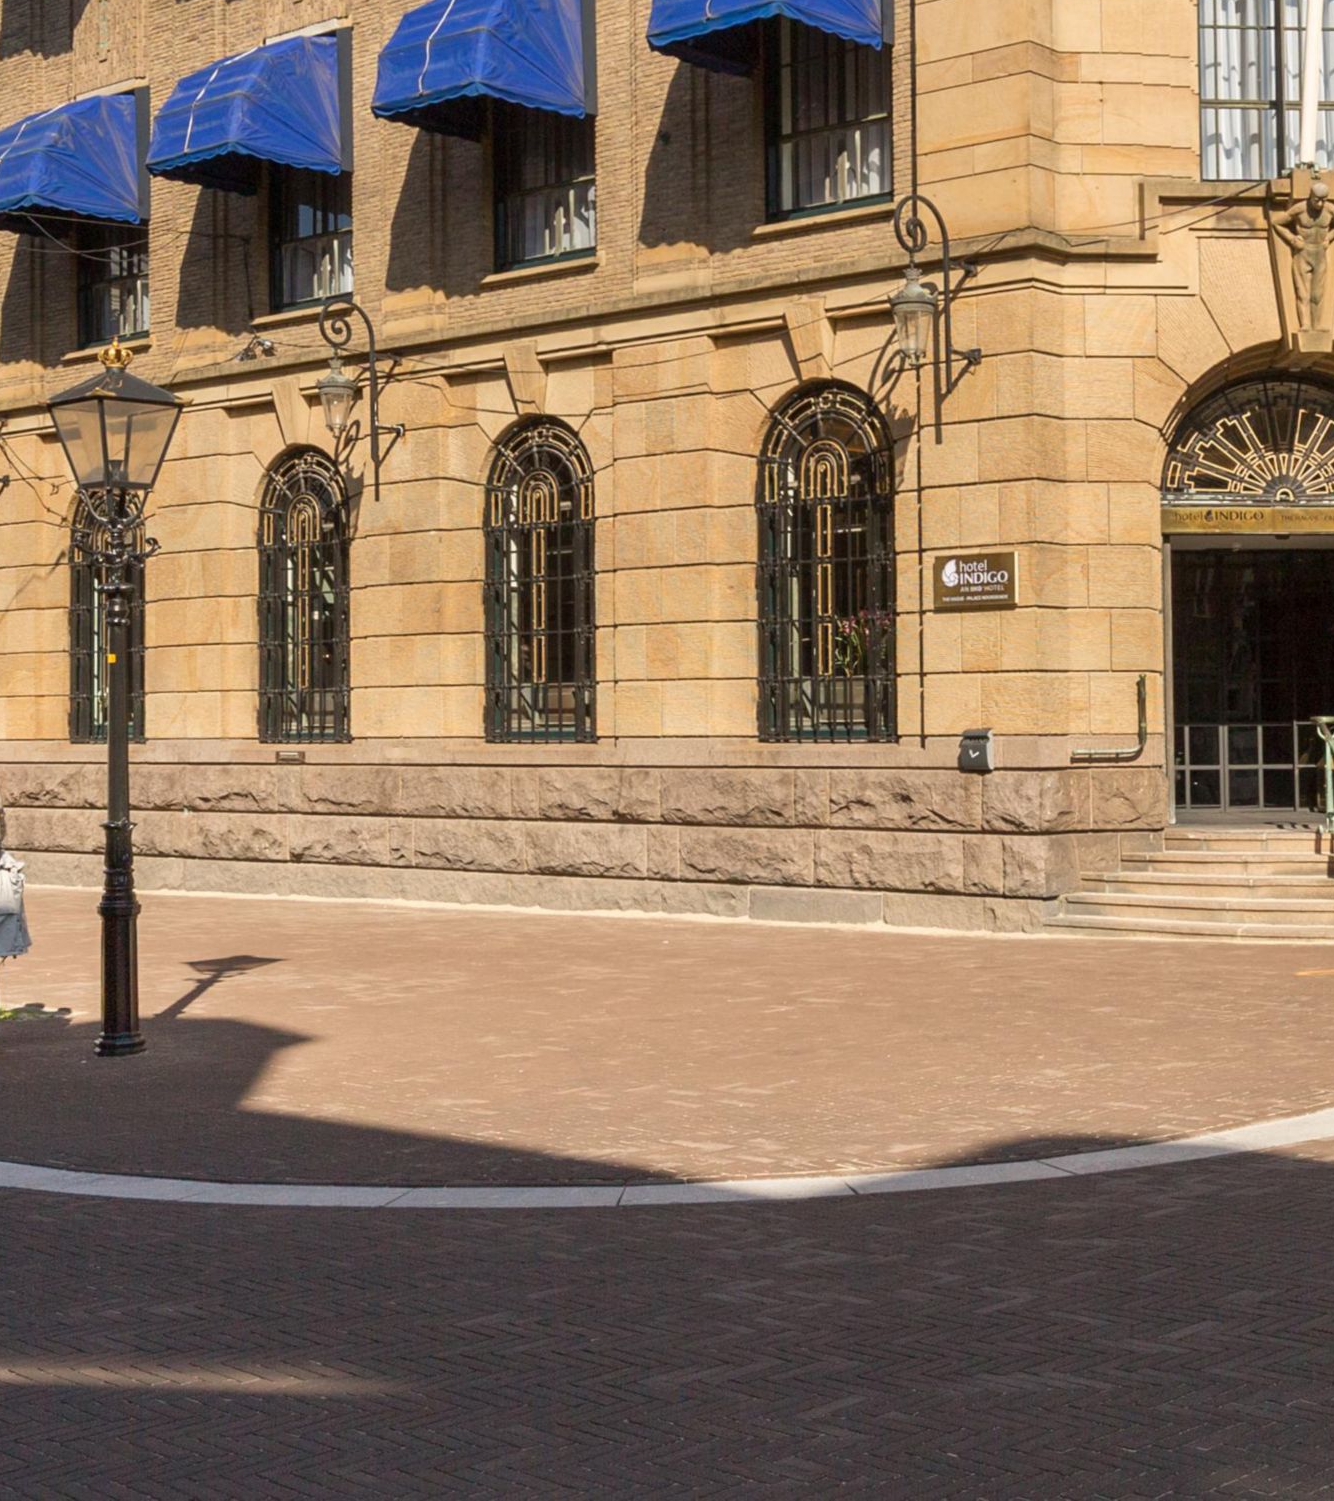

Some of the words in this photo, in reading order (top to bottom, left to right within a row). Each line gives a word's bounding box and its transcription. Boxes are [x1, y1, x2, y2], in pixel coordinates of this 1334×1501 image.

[1175, 510, 1203, 522] hotel
[1214, 510, 1264, 522] INDIGO
[960, 559, 988, 572] hotel
[960, 570, 1009, 585] INDIGO
[984, 584, 1005, 592] HOTEL
